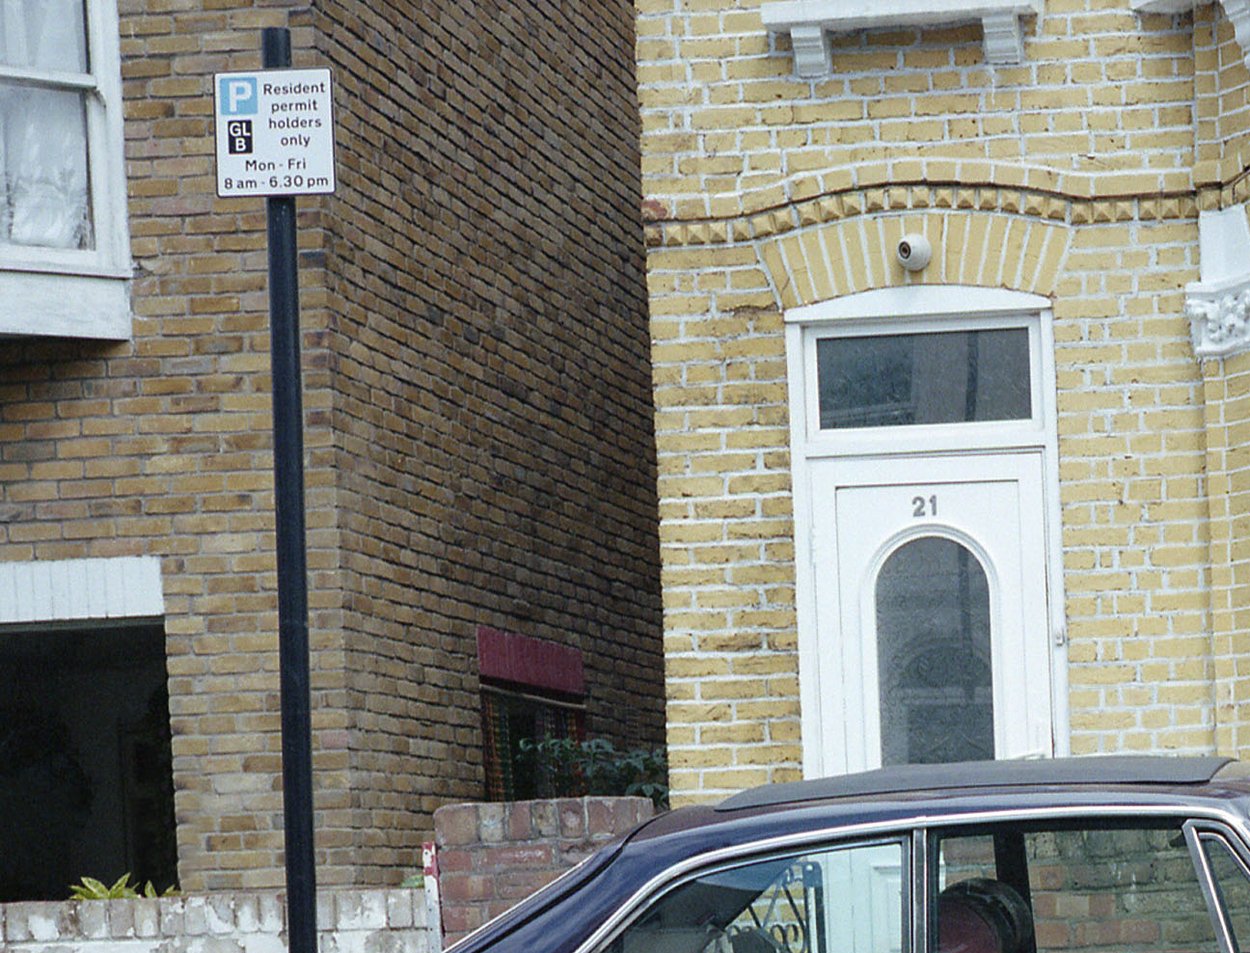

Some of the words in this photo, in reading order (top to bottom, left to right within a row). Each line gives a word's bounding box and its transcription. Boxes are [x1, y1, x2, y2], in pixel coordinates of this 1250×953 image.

[263, 82, 325, 95] Resident
[228, 81, 252, 112] P
[271, 99, 318, 114] permit
[229, 122, 251, 137] GL
[269, 117, 322, 129] holders
[235, 138, 246, 152] B
[280, 134, 311, 148] only
[245, 159, 275, 171] Mon
[288, 158, 306, 170] Fri
[224, 178, 233, 189] 8
[236, 179, 257, 188] am
[269, 175, 304, 188] 6.30
[307, 177, 329, 188] pm
[912, 494, 937, 517] 21
